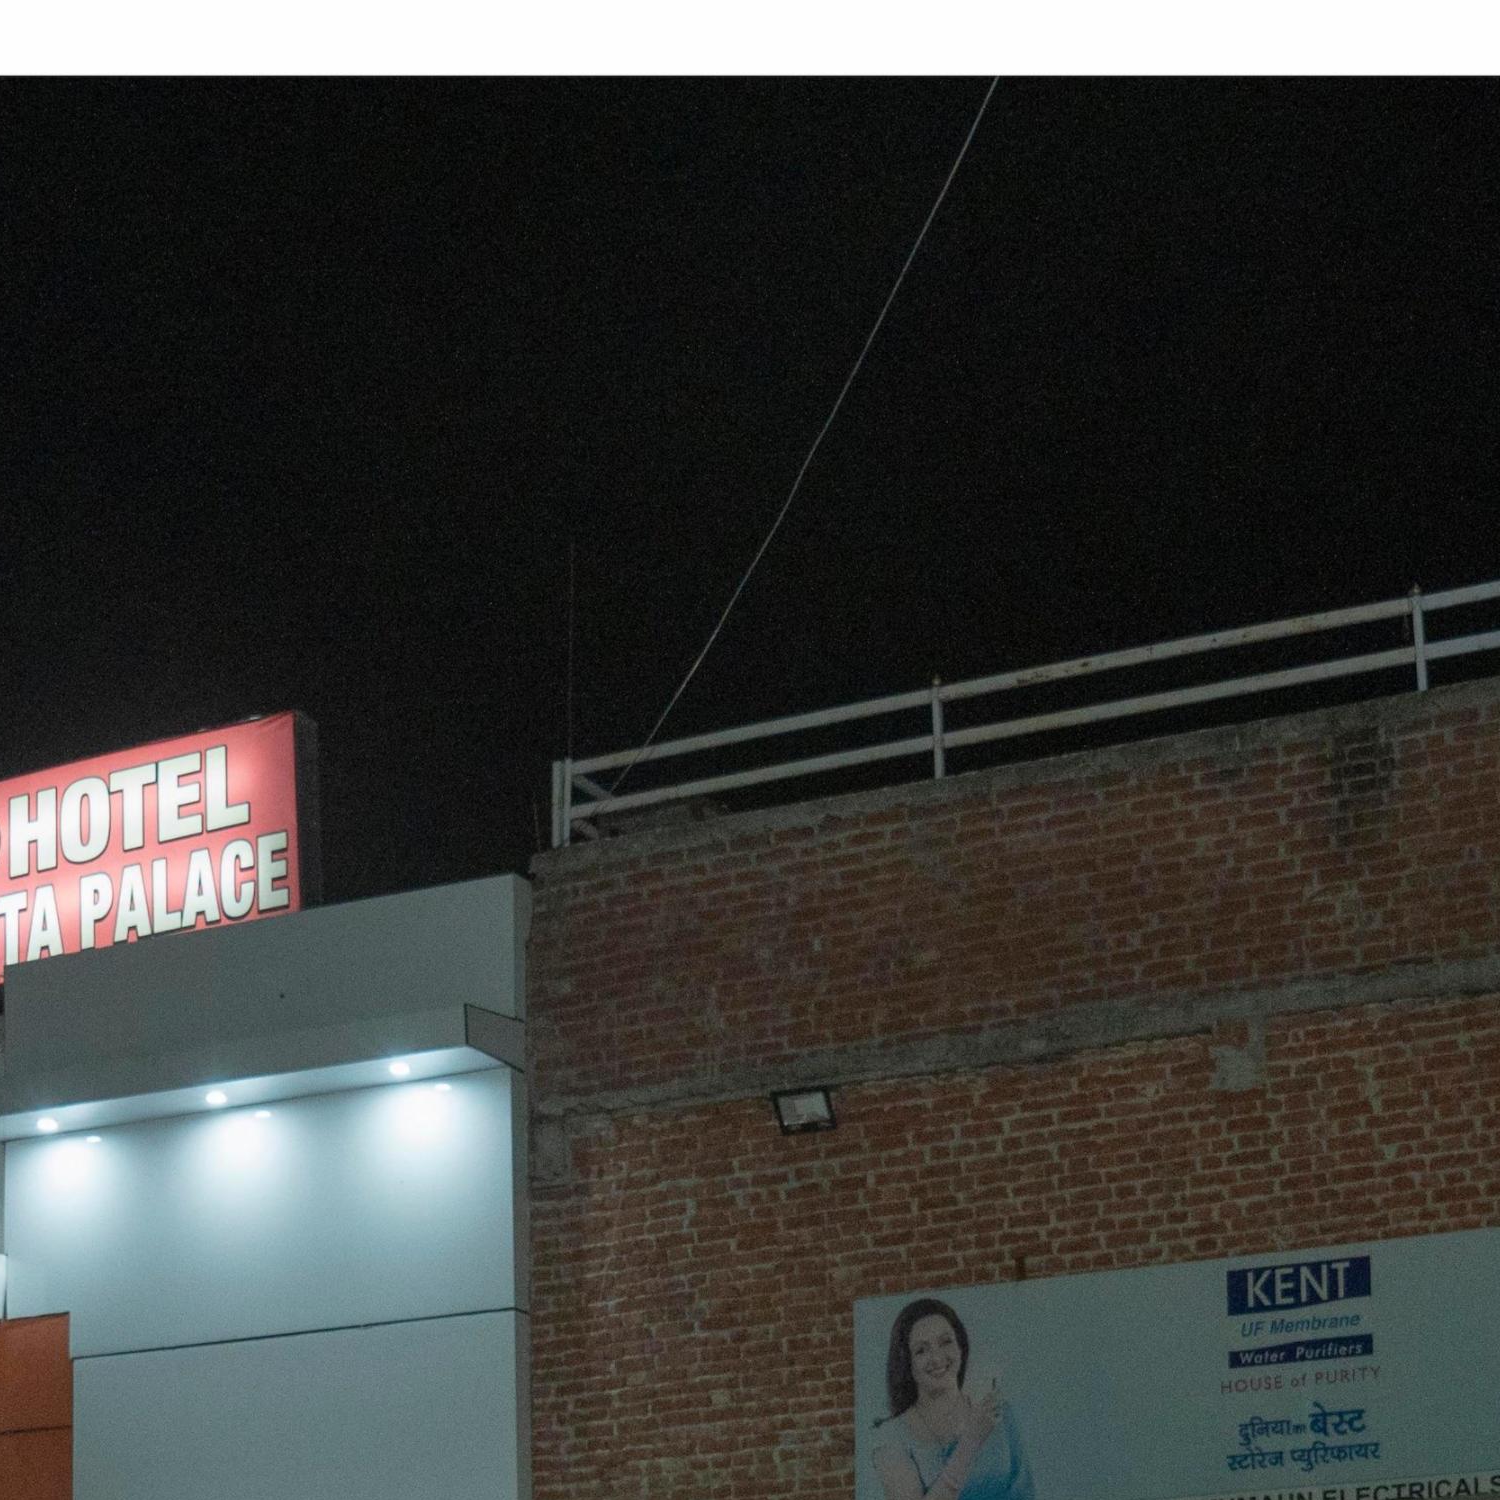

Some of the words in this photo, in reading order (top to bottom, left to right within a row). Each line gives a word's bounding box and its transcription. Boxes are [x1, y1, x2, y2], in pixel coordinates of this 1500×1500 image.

[8, 745, 251, 879] HOTEL
[78, 831, 290, 951] PALACE
[1246, 1261, 1350, 1308] KENT
[1240, 1321, 1266, 1338] UF
[1269, 1313, 1361, 1334] Membrane
[1239, 1350, 1286, 1364] Water
[1295, 1342, 1364, 1359] Purifiers
[1220, 1375, 1283, 1394] HOUSE
[1290, 1374, 1307, 1387] of
[1315, 1366, 1382, 1385] PURITY
[1239, 1416, 1292, 1446] दुनिया
[1309, 1401, 1366, 1436] बेस्ट
[1227, 1447, 1284, 1471] स्टोरेज
